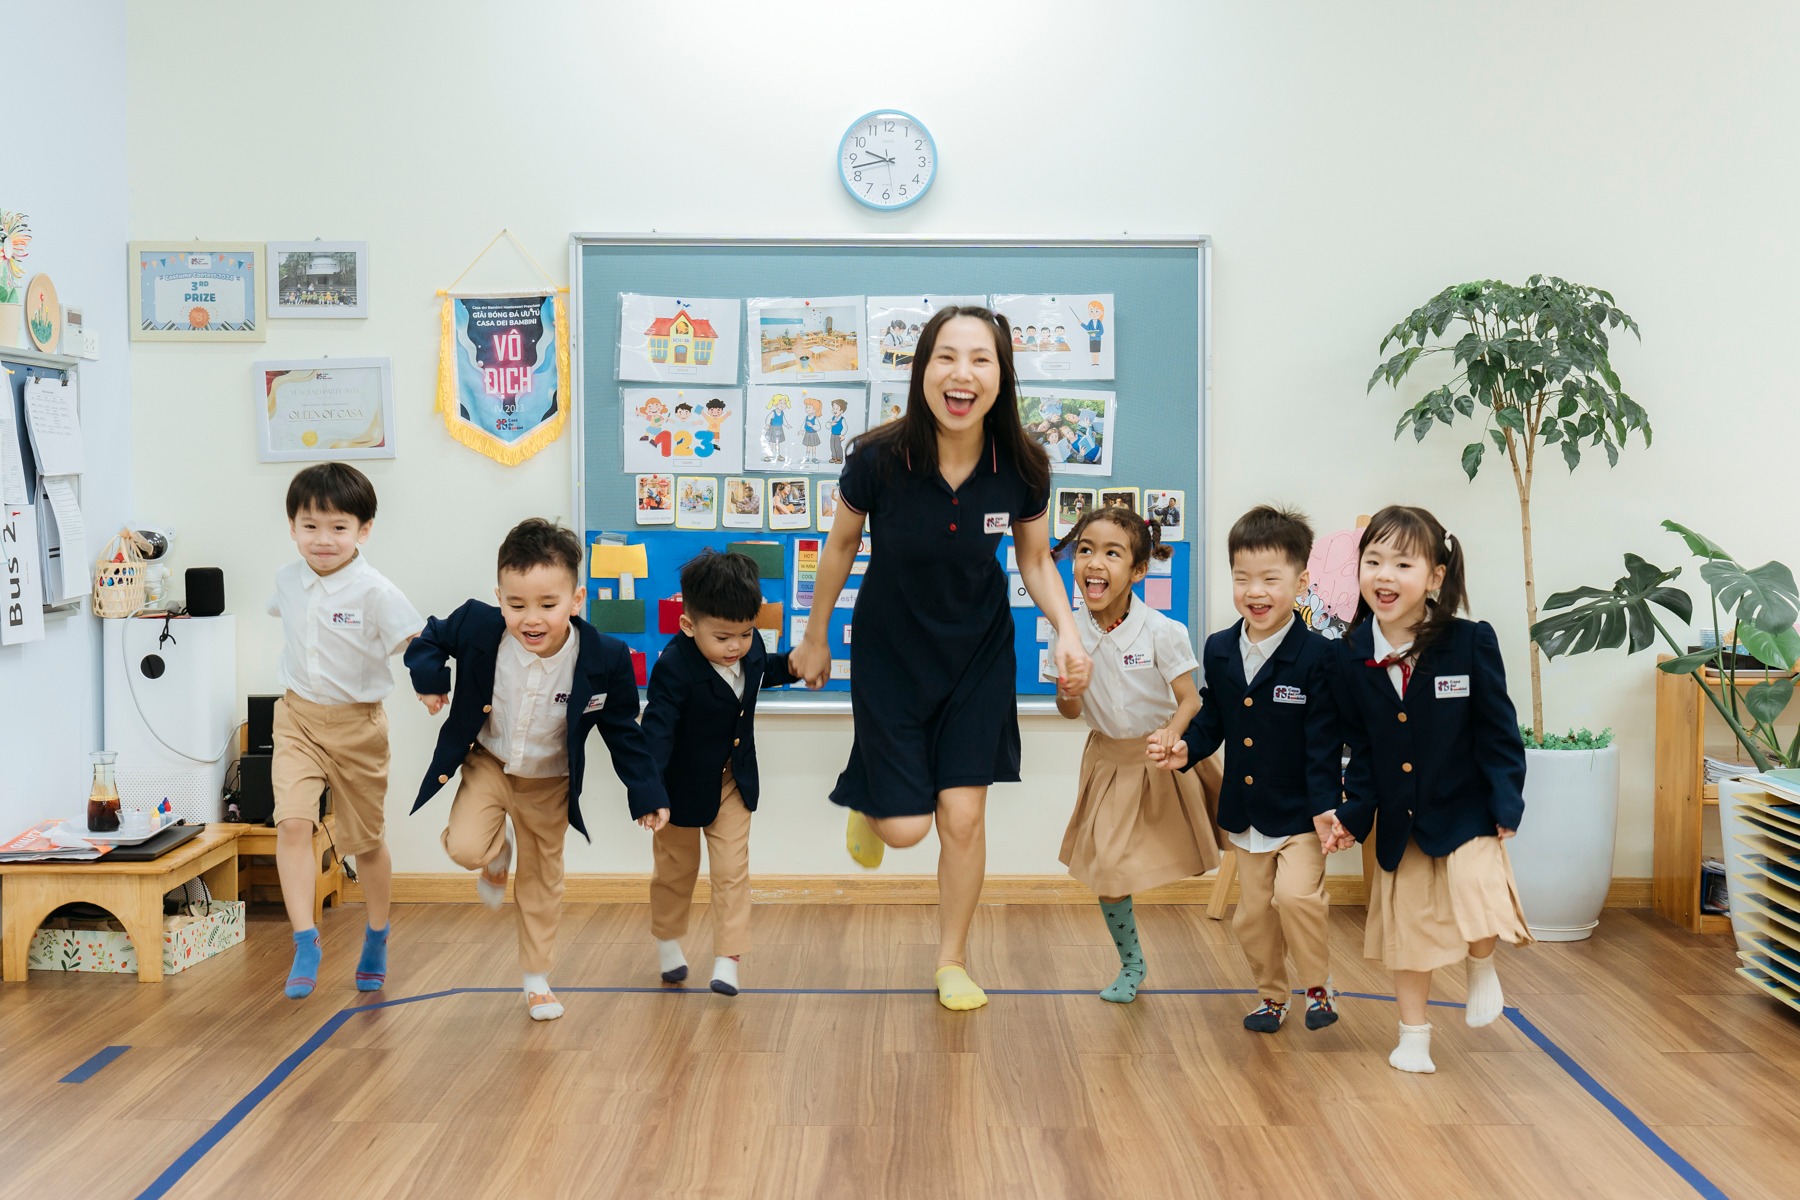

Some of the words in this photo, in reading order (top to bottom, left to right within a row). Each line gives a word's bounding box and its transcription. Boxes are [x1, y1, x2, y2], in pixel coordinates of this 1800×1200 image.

[868, 125, 877, 136] 11
[884, 121, 896, 132] 12
[855, 136, 866, 148] 10
[914, 139, 923, 151] 2
[849, 153, 858, 165] 9
[918, 156, 927, 168] 3
[853, 170, 862, 182] 8
[911, 173, 920, 185] 4
[866, 182, 874, 194] 7
[881, 188, 890, 200] 6
[898, 184, 907, 196] 5
[165, 272, 192, 281] Costume
[184, 293, 216, 302] PRIZE
[488, 310, 507, 319] BÓNG
[509, 309, 519, 318] ĐÁ
[509, 318, 537, 326] BAMBINI
[493, 329, 522, 361] VÔ
[484, 367, 532, 400] ĐỊCH
[3, 521, 17, 543] 2
[8, 557, 24, 627] Bus
